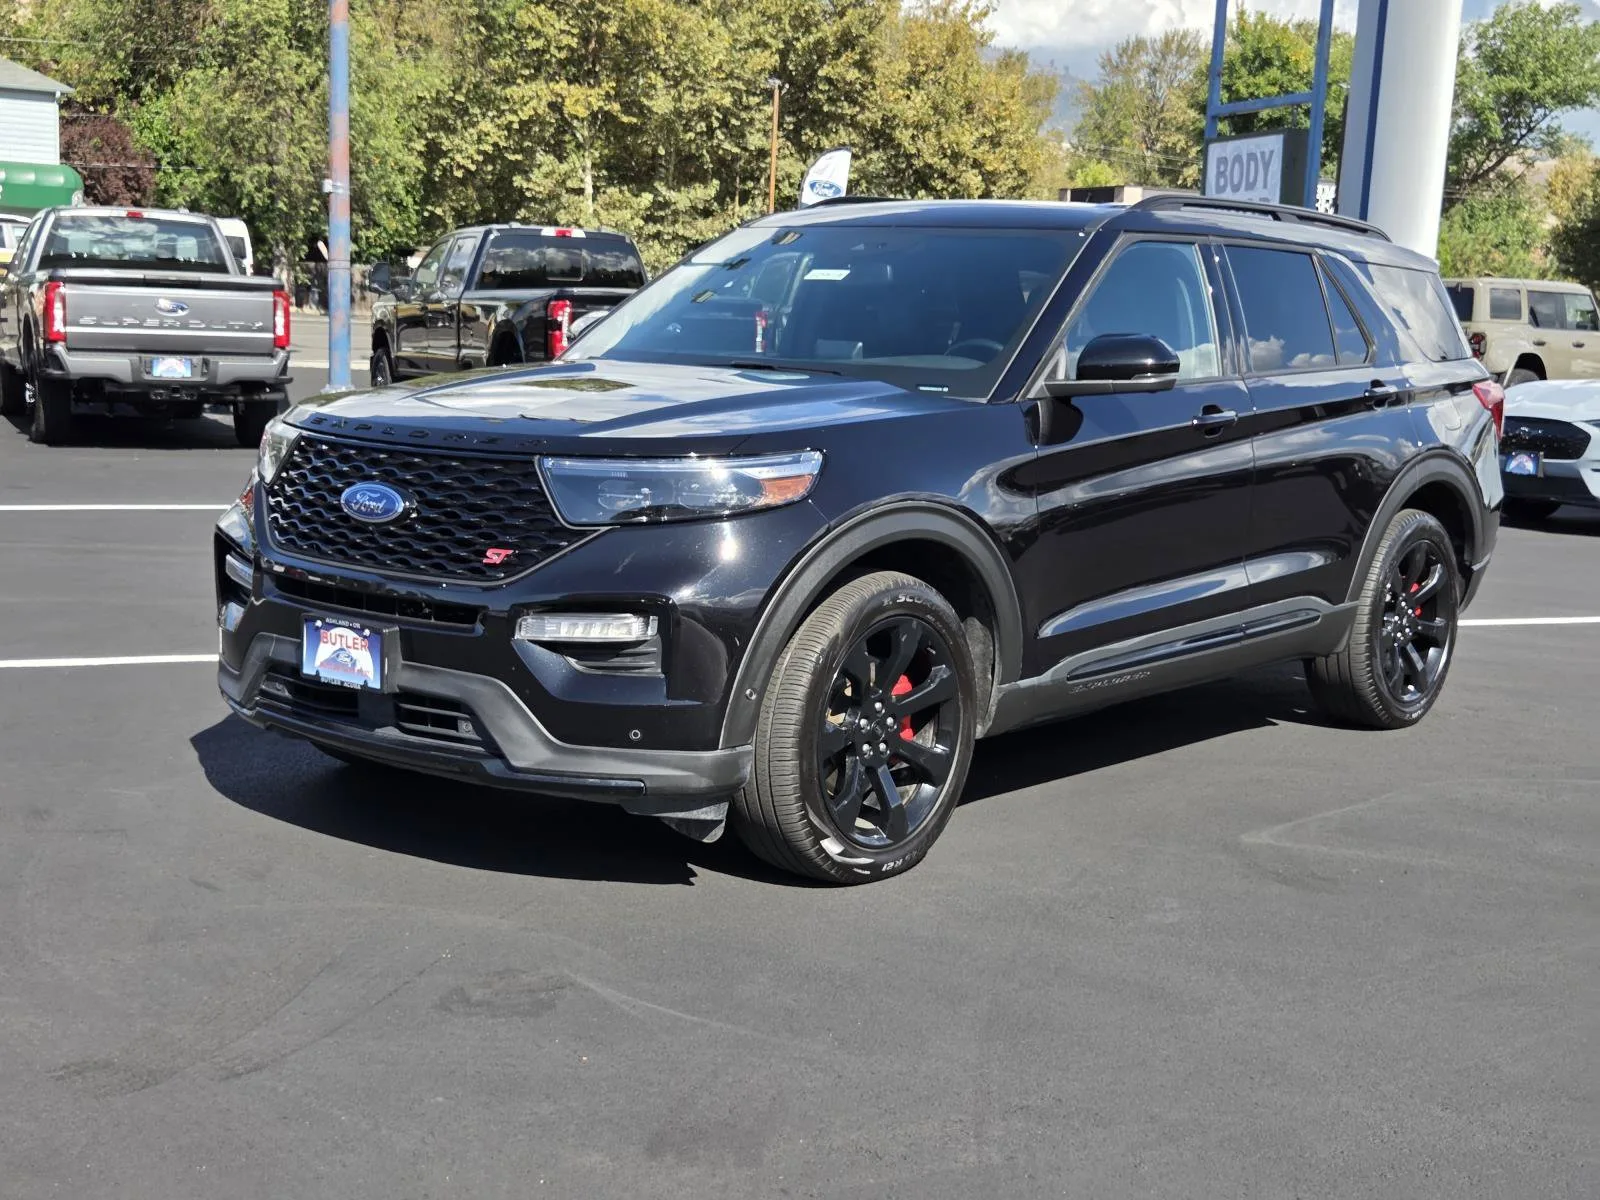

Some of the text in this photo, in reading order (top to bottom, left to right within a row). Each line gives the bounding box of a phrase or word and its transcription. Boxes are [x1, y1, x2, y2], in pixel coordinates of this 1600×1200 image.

[1215, 150, 1275, 195] BODY
[351, 489, 387, 514] Ford
[482, 548, 514, 565] ST
[320, 630, 369, 651] BUTLER
